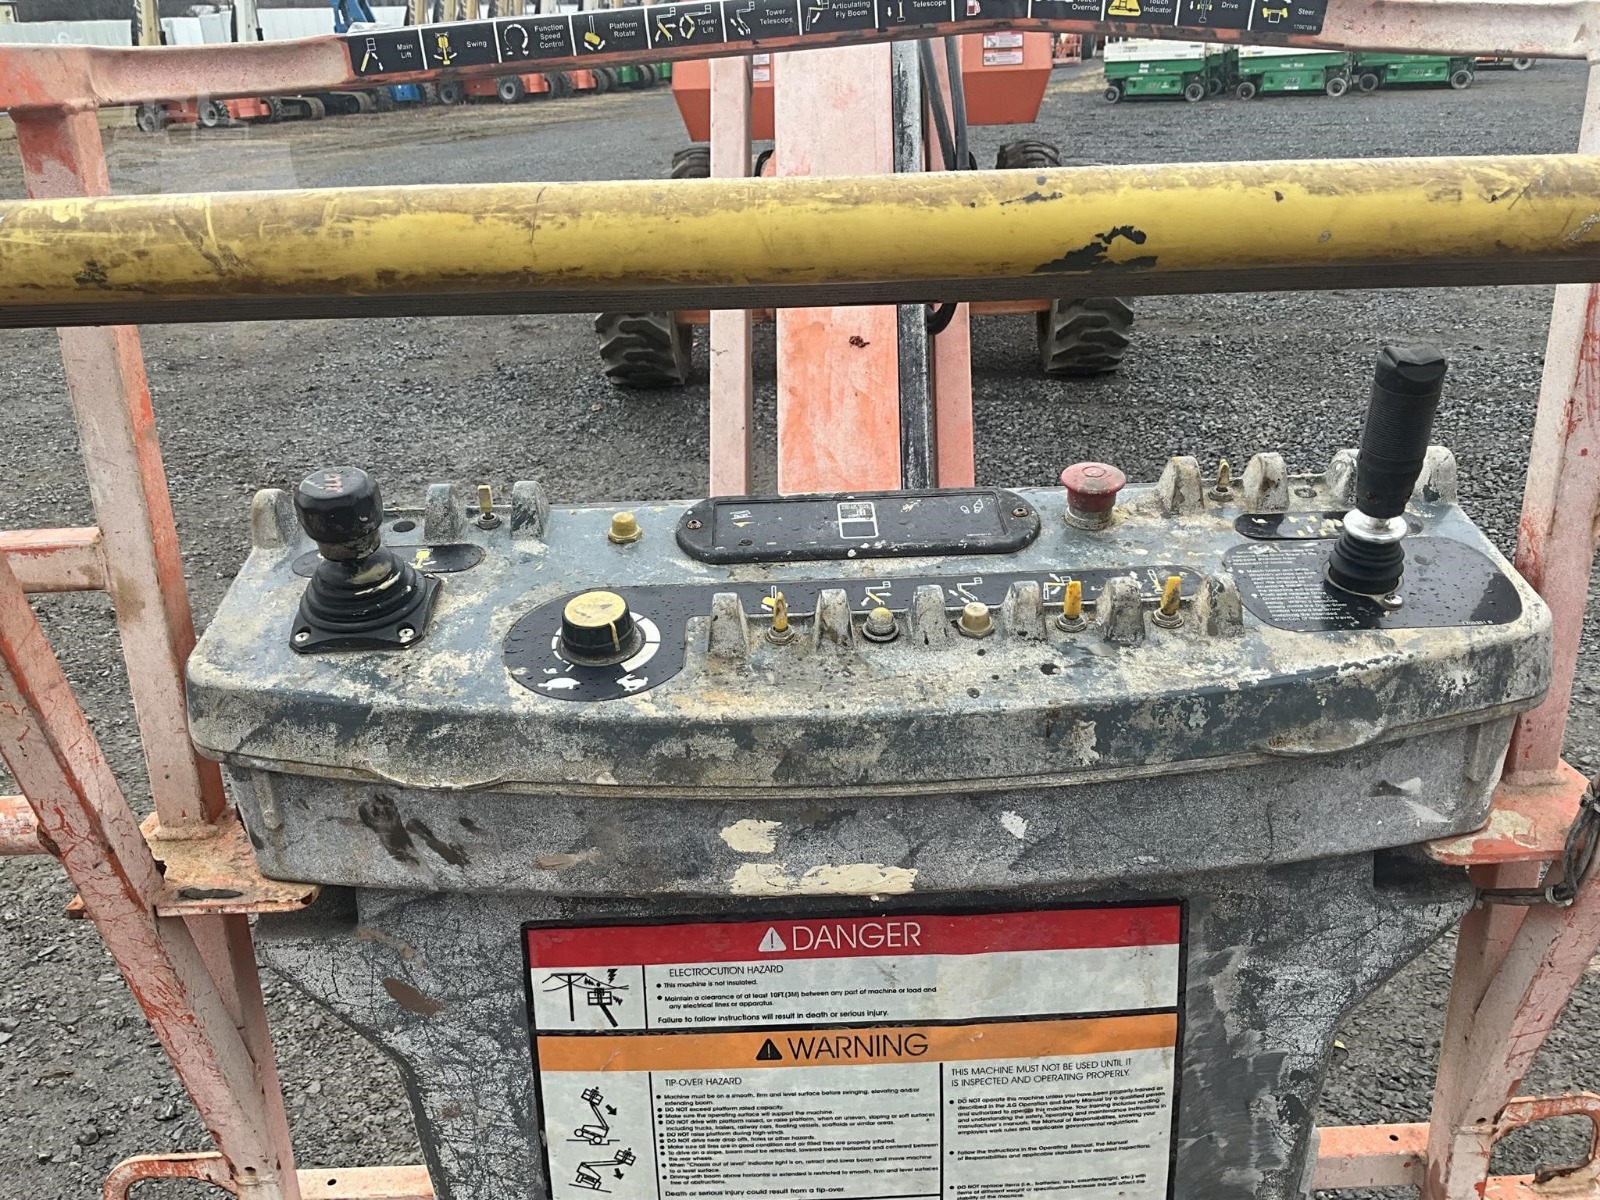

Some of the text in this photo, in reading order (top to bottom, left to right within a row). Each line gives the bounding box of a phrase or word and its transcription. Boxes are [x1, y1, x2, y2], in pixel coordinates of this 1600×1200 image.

[832, 0, 871, 10] Articulating
[913, 0, 947, 8] Telescope
[1072, 2, 1100, 11] Override
[835, 11, 846, 19] Fly
[609, 21, 638, 30] Platform
[697, 17, 717, 26] Tower
[760, 16, 793, 26] Telescope
[534, 24, 564, 32] Function
[702, 26, 714, 34] Lift
[540, 32, 561, 41] Speed
[614, 28, 635, 38] Rotate
[466, 40, 487, 49] Swing
[539, 40, 564, 49] Control
[792, 922, 920, 950] DANGER
[669, 965, 784, 977] ELECTROCUTION HAZARD
[788, 1033, 928, 1060] WARNING
[952, 1068, 968, 1076] THIS
[971, 1066, 1013, 1076] MACHINE
[1016, 1064, 1039, 1073] MUST
[1042, 1063, 1060, 1072] NOT
[1076, 1061, 1099, 1070] USED
[1100, 1059, 1122, 1068] UNTIL
[665, 1077, 742, 1086] TIP-OVER HAZARD
[961, 1076, 1009, 1087] INSPECTED
[1011, 1076, 1031, 1084] AND
[1033, 1072, 1083, 1083] OPERATING
[1086, 1069, 1130, 1079] PROPERLY.
